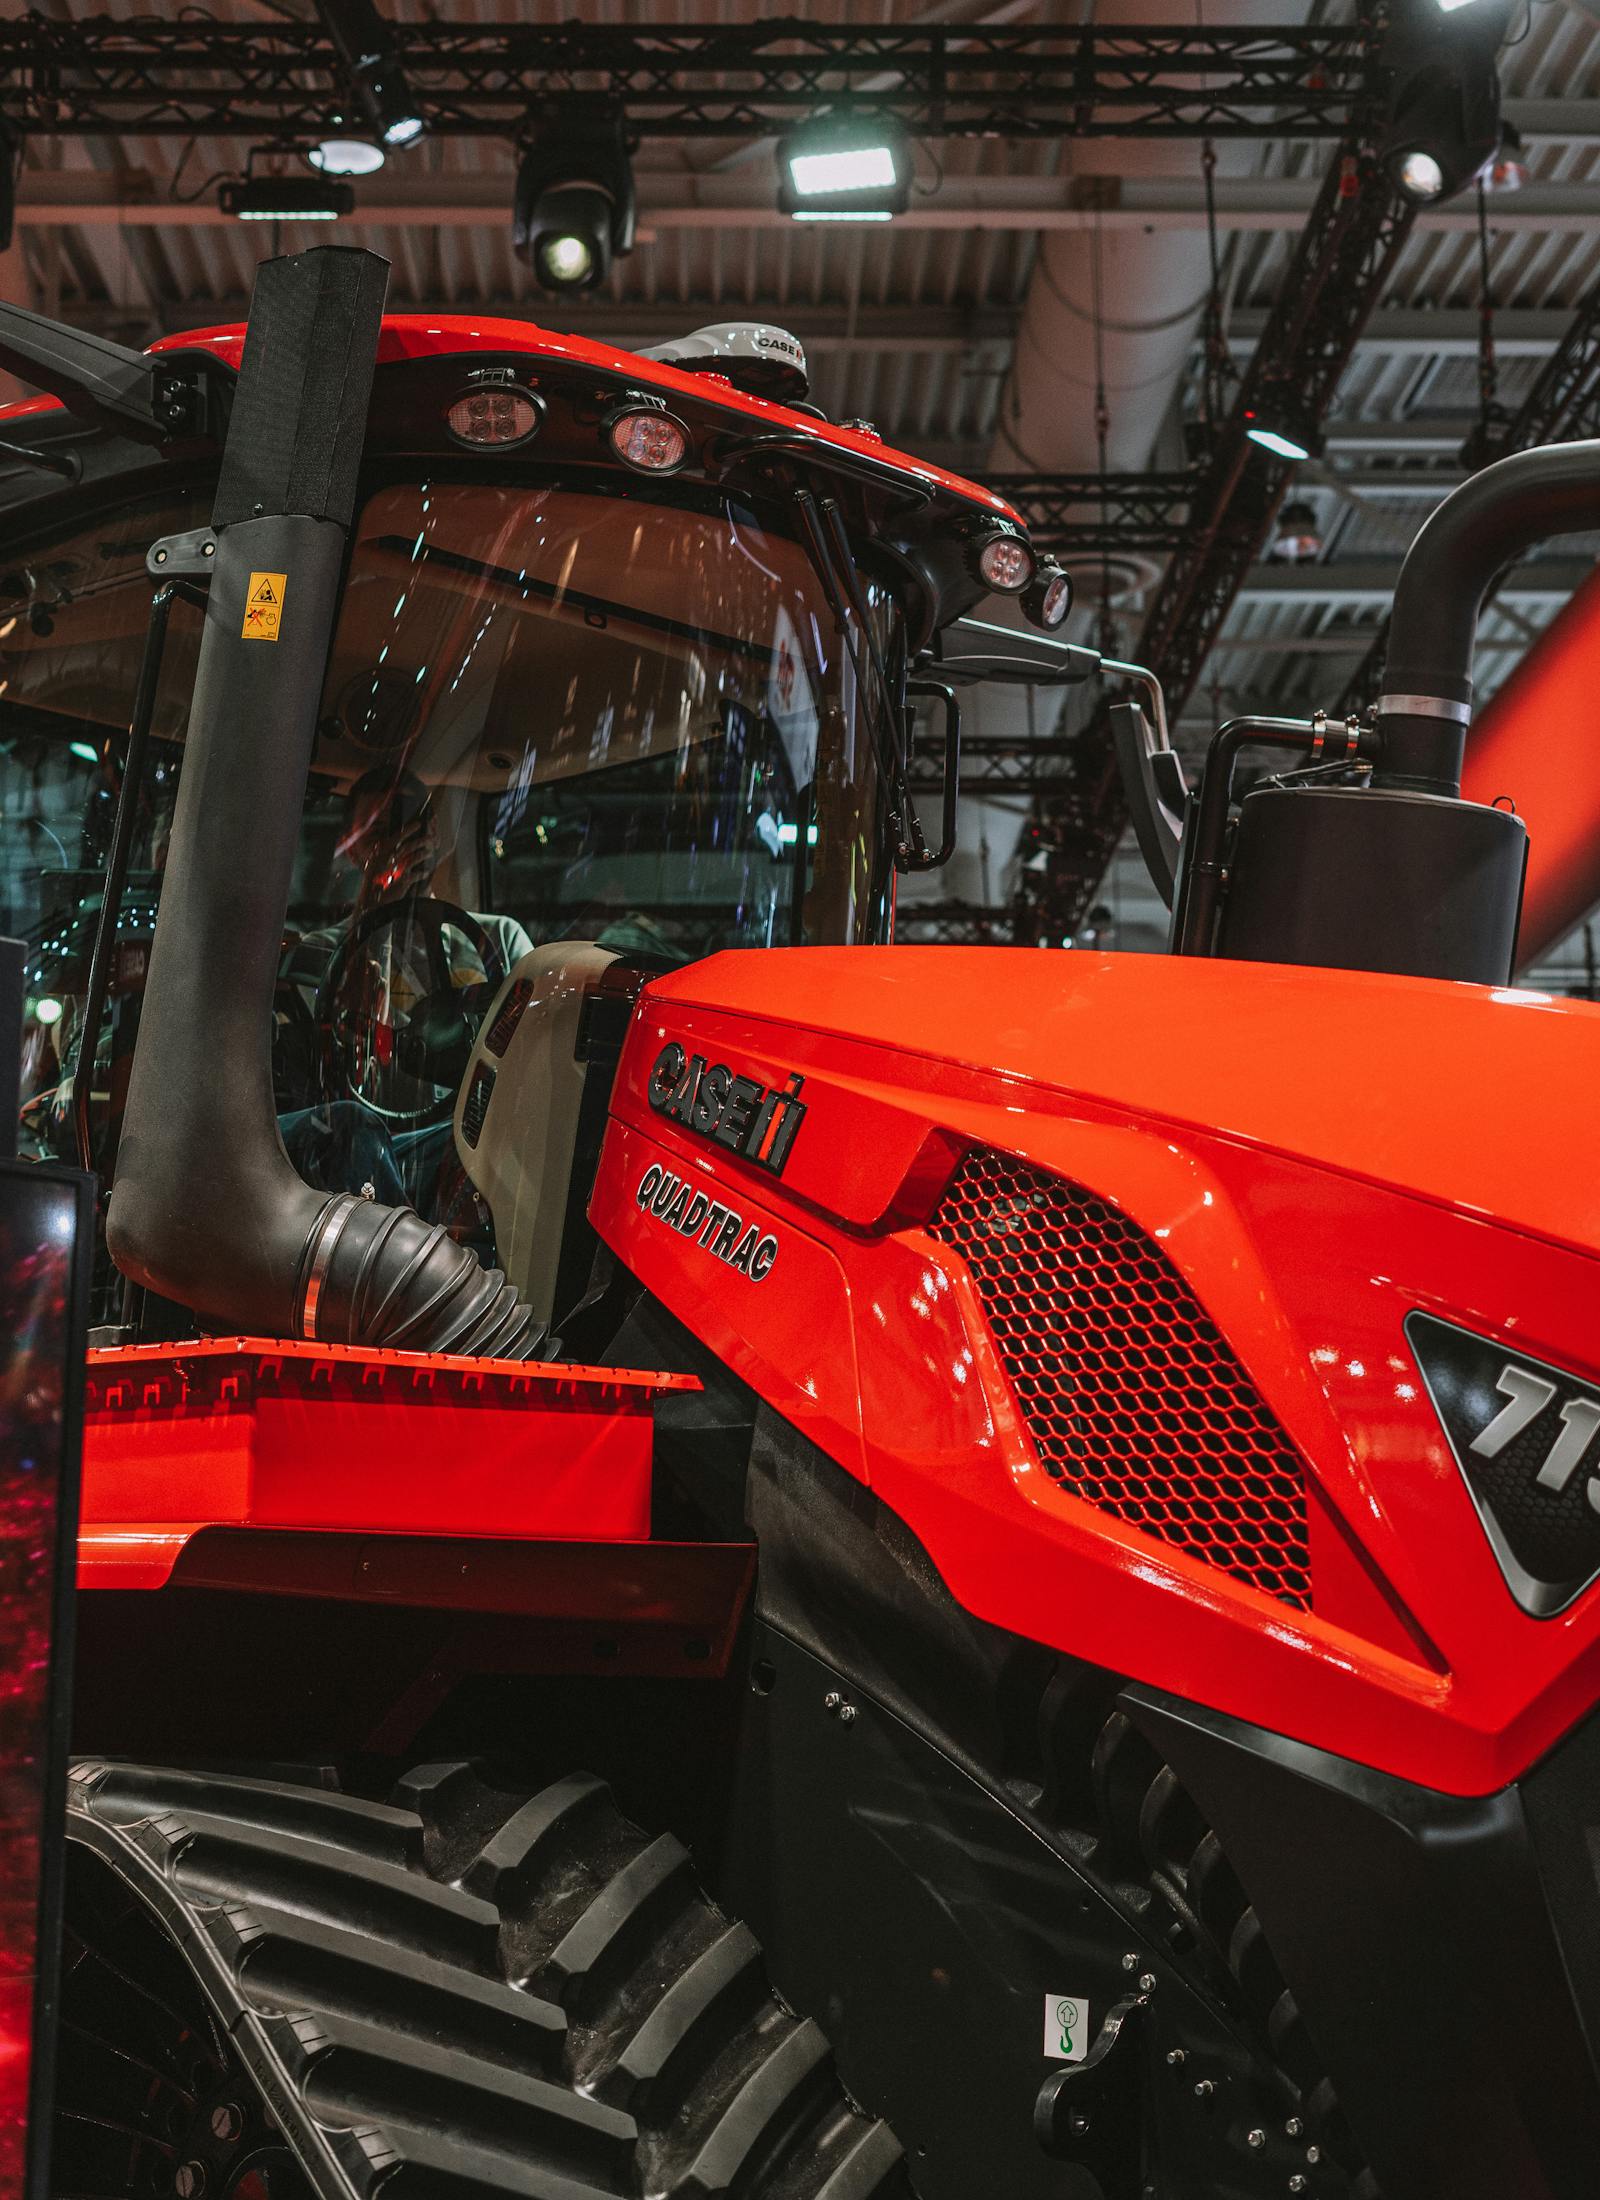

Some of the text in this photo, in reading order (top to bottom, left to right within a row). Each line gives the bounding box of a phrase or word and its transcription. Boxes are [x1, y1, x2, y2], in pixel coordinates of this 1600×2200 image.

[758, 338, 795, 355] CASE
[649, 1041, 764, 1150] CASE
[636, 1163, 778, 1283] QUADTRAC
[1469, 1364, 1600, 1515] 71
